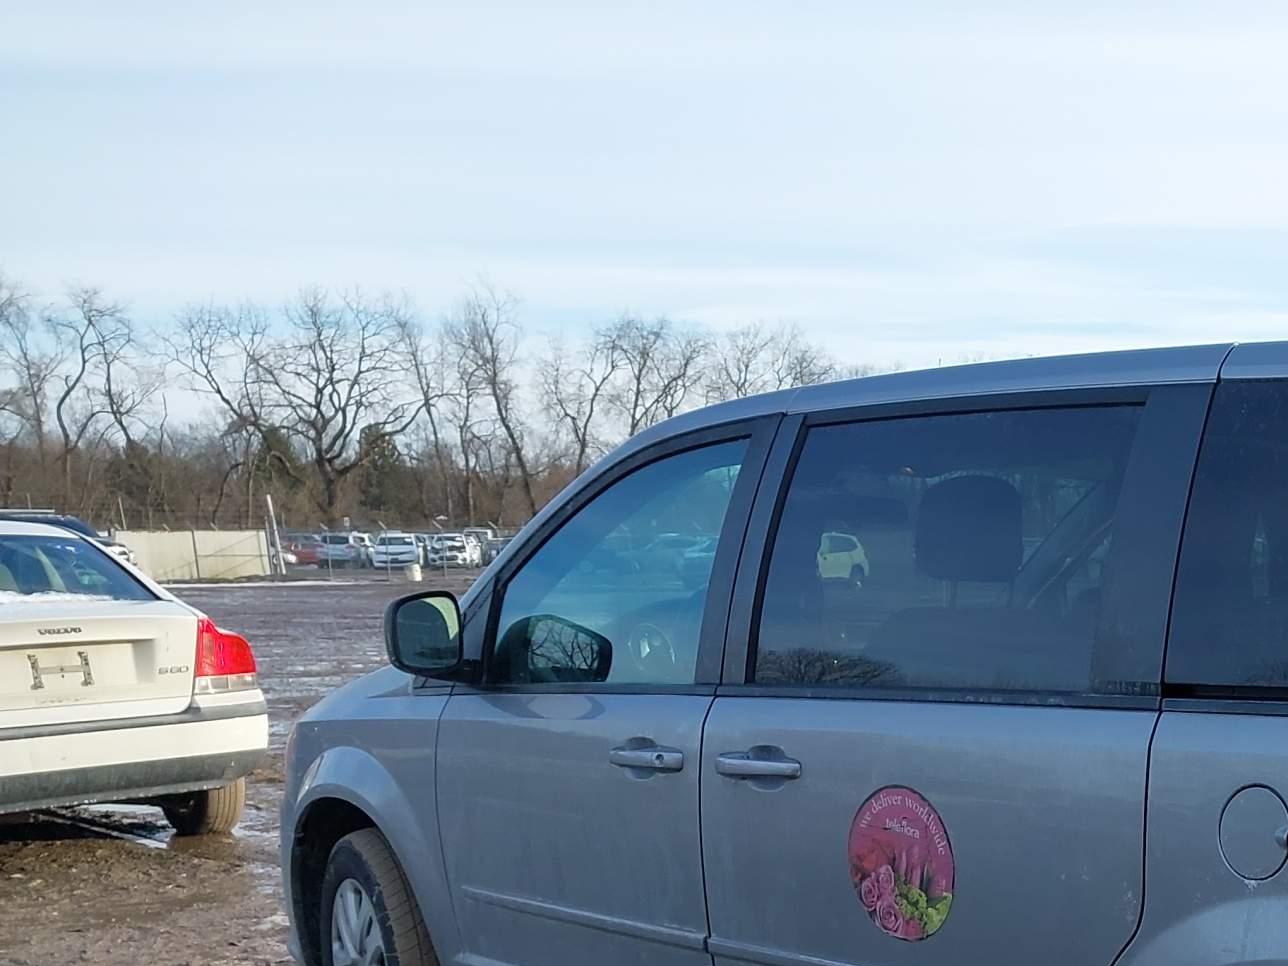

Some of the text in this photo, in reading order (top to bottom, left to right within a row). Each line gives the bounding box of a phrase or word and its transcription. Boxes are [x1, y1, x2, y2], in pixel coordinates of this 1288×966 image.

[36, 626, 82, 635] VOLVO
[871, 793, 903, 814] deliver
[905, 796, 946, 856] worldwide
